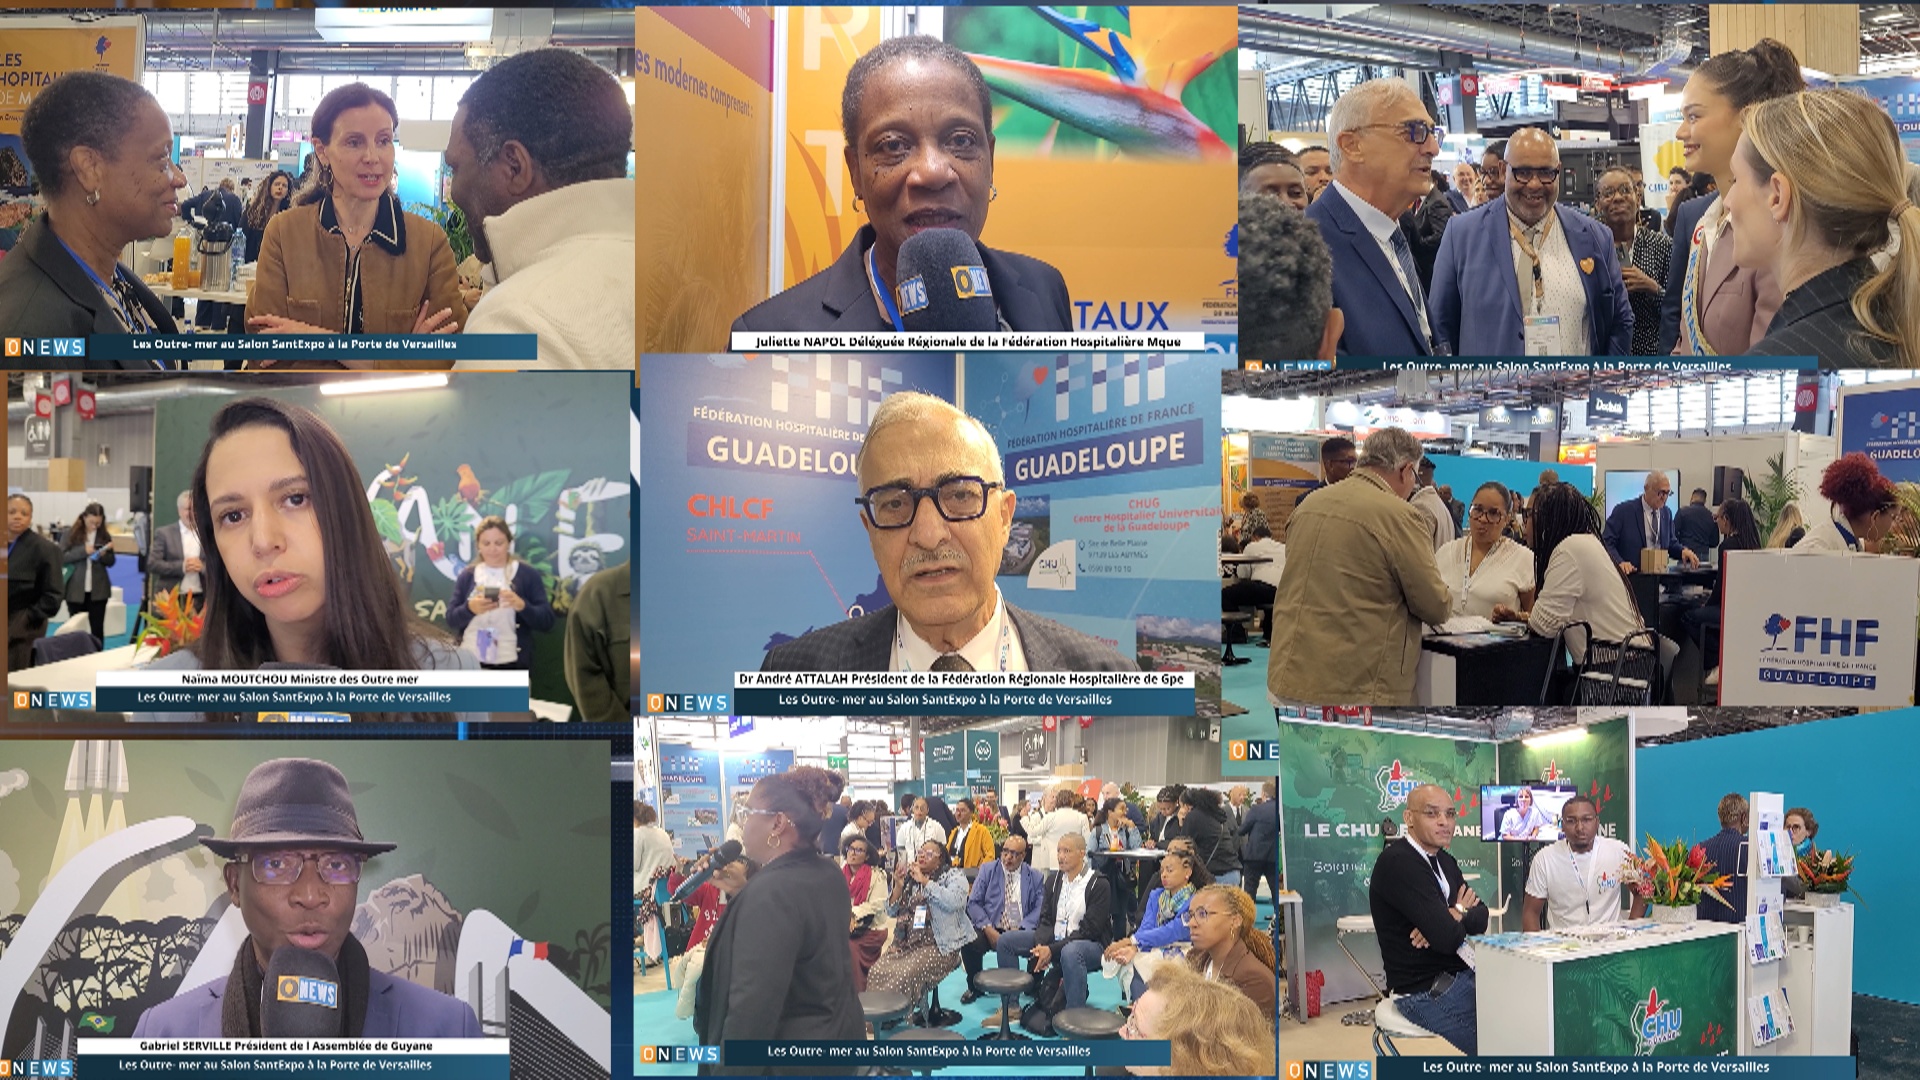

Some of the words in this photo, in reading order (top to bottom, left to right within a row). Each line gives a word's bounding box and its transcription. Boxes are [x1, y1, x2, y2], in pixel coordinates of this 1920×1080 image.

[654, 57, 708, 99] modernes
[710, 84, 750, 118] comprenant
[1073, 301, 1170, 331] TAUX
[693, 405, 773, 429] FÉDÉRATION
[775, 420, 851, 441] HOSPITALIÈRE
[1059, 416, 1128, 440] HOSPITALIÈRE
[1130, 413, 1144, 425] DE
[1148, 402, 1196, 421] FRANCE
[1014, 431, 1186, 481] GUADELOUPE
[686, 493, 774, 520] CHLCF
[1073, 513, 1102, 524] Centre
[1104, 508, 1156, 522] Hospitalier
[1128, 497, 1160, 509] CHUG
[686, 528, 801, 544] SAINT-MARTIN
[1103, 523, 1115, 533] de
[1117, 523, 1126, 532] la
[1128, 521, 1191, 534] Guadeloupe
[1794, 615, 1880, 657] FHF
[1763, 669, 1872, 687] GUADELOUPE
[1304, 823, 1331, 837] LE
[1335, 823, 1380, 837] CHU
[1641, 1007, 1683, 1039] CHU
